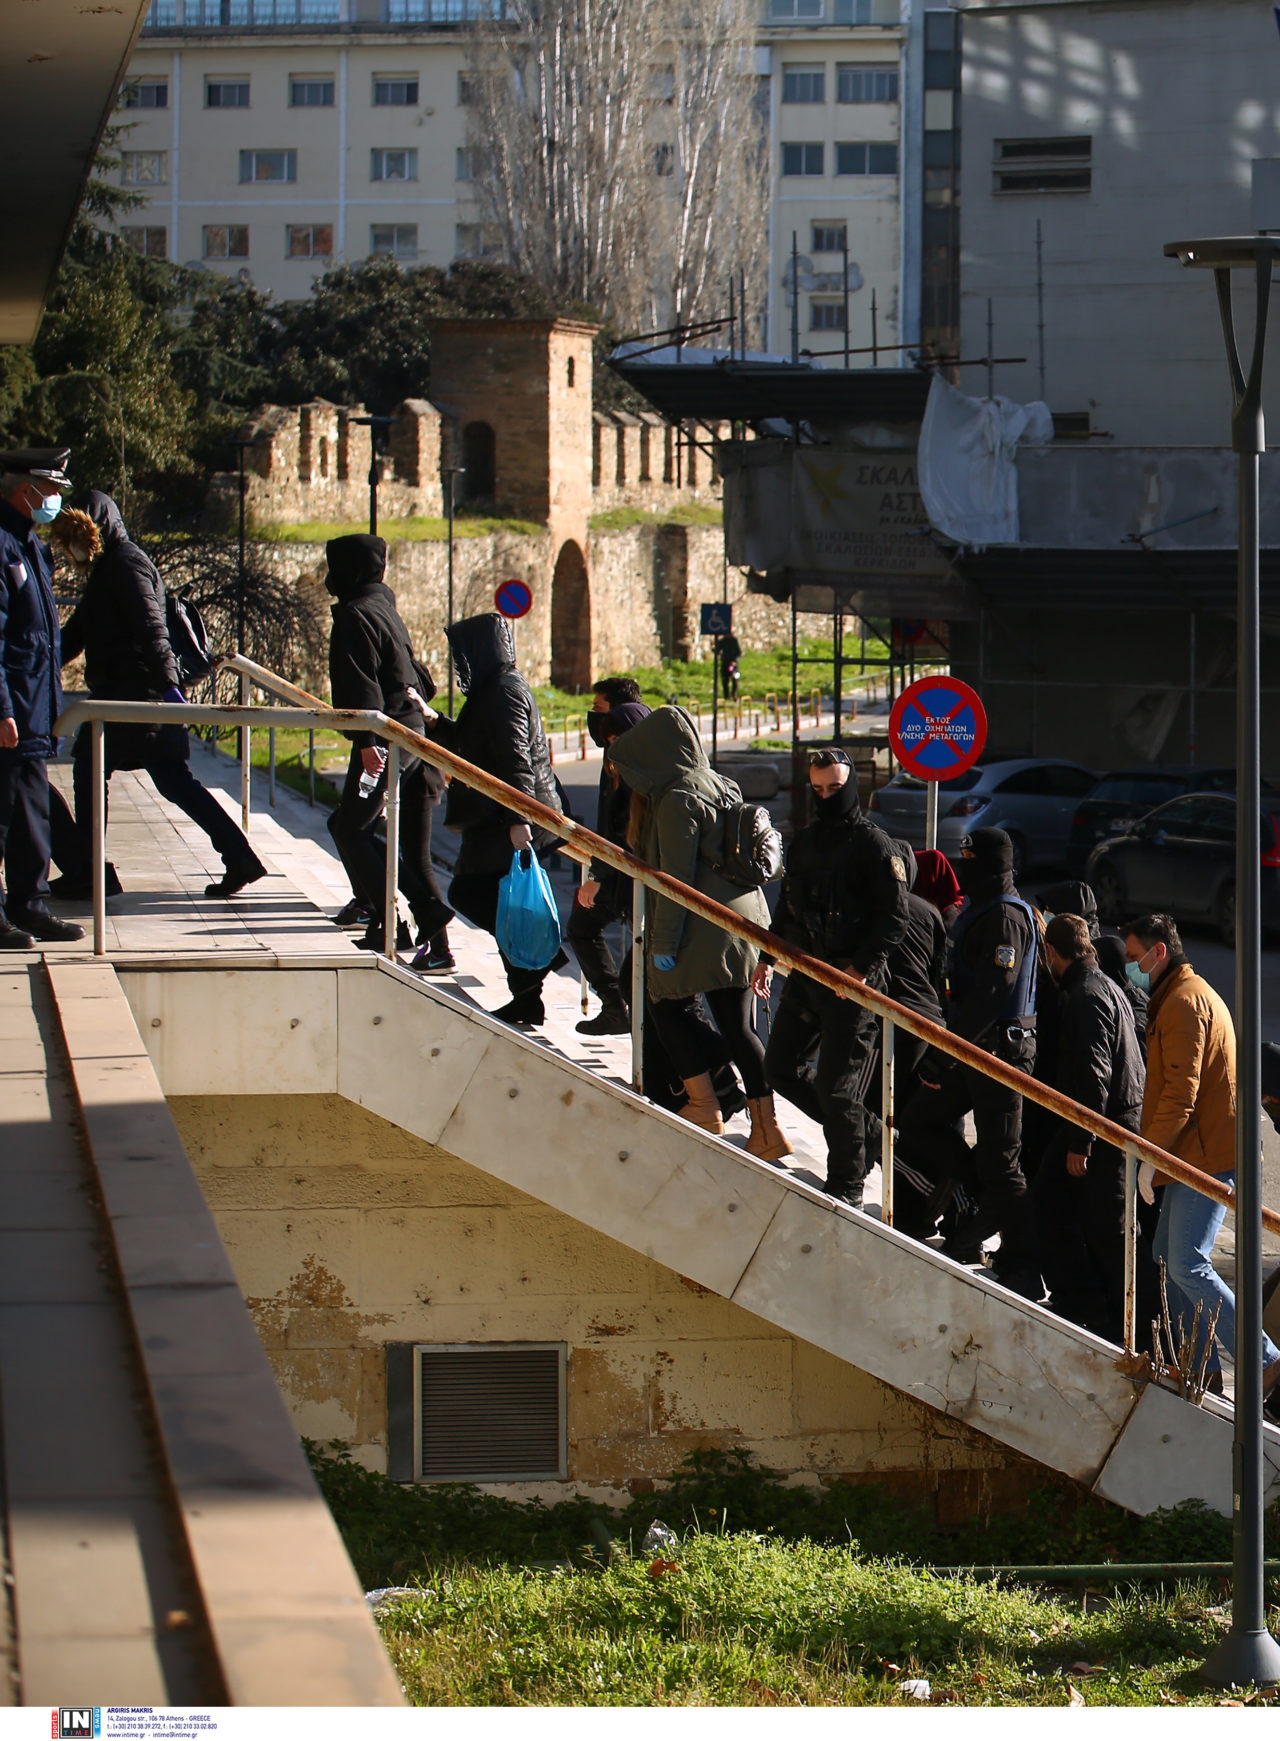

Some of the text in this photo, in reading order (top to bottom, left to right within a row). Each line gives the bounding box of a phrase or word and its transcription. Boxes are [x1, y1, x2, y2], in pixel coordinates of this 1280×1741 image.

[856, 465, 918, 486] ΣΚΑΛ
[880, 492, 925, 513] ΑΣΤ
[925, 716, 951, 724] ΕΚΤΟΣ
[906, 724, 967, 733] ΔΥΟ ΟΧΗΜΑΤΩΝ
[929, 733, 975, 741] ΜΕΤΑΓΩΓΩΝ
